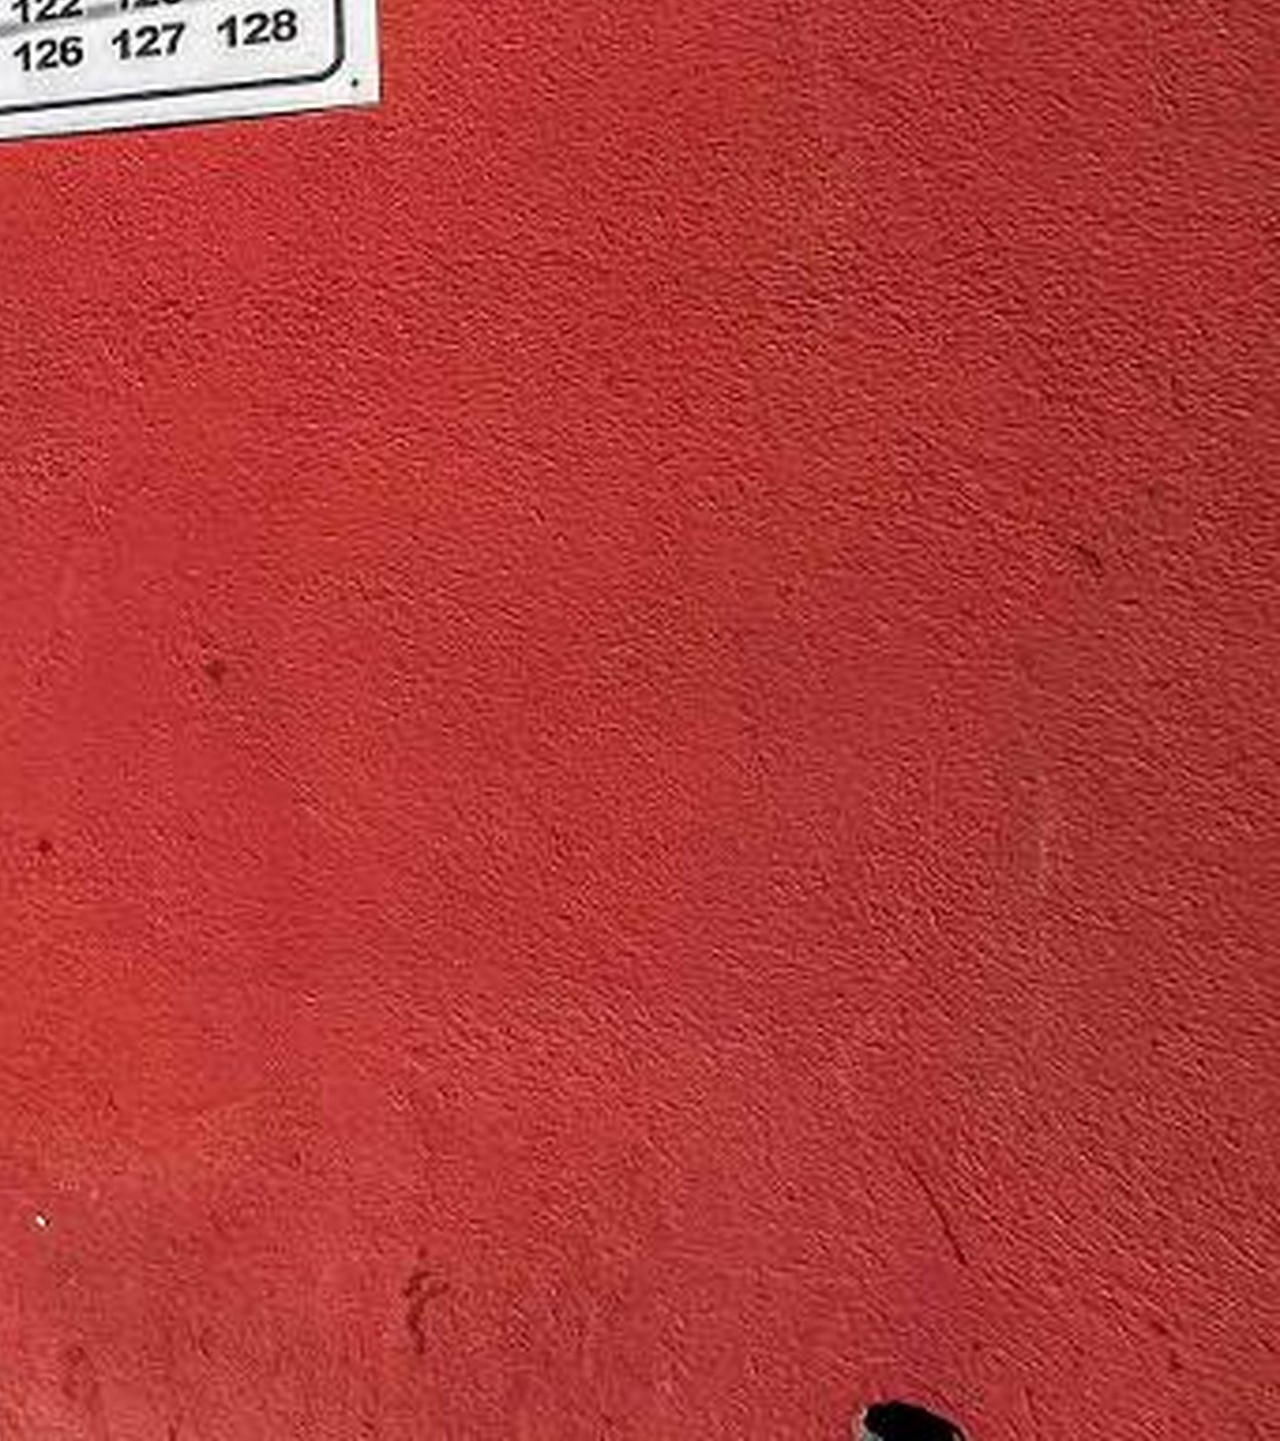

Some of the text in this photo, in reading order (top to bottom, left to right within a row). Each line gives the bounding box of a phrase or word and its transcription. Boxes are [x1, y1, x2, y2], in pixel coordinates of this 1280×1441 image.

[13, 36, 83, 72] 126
[111, 22, 187, 59] 127
[216, 9, 297, 48] 128
